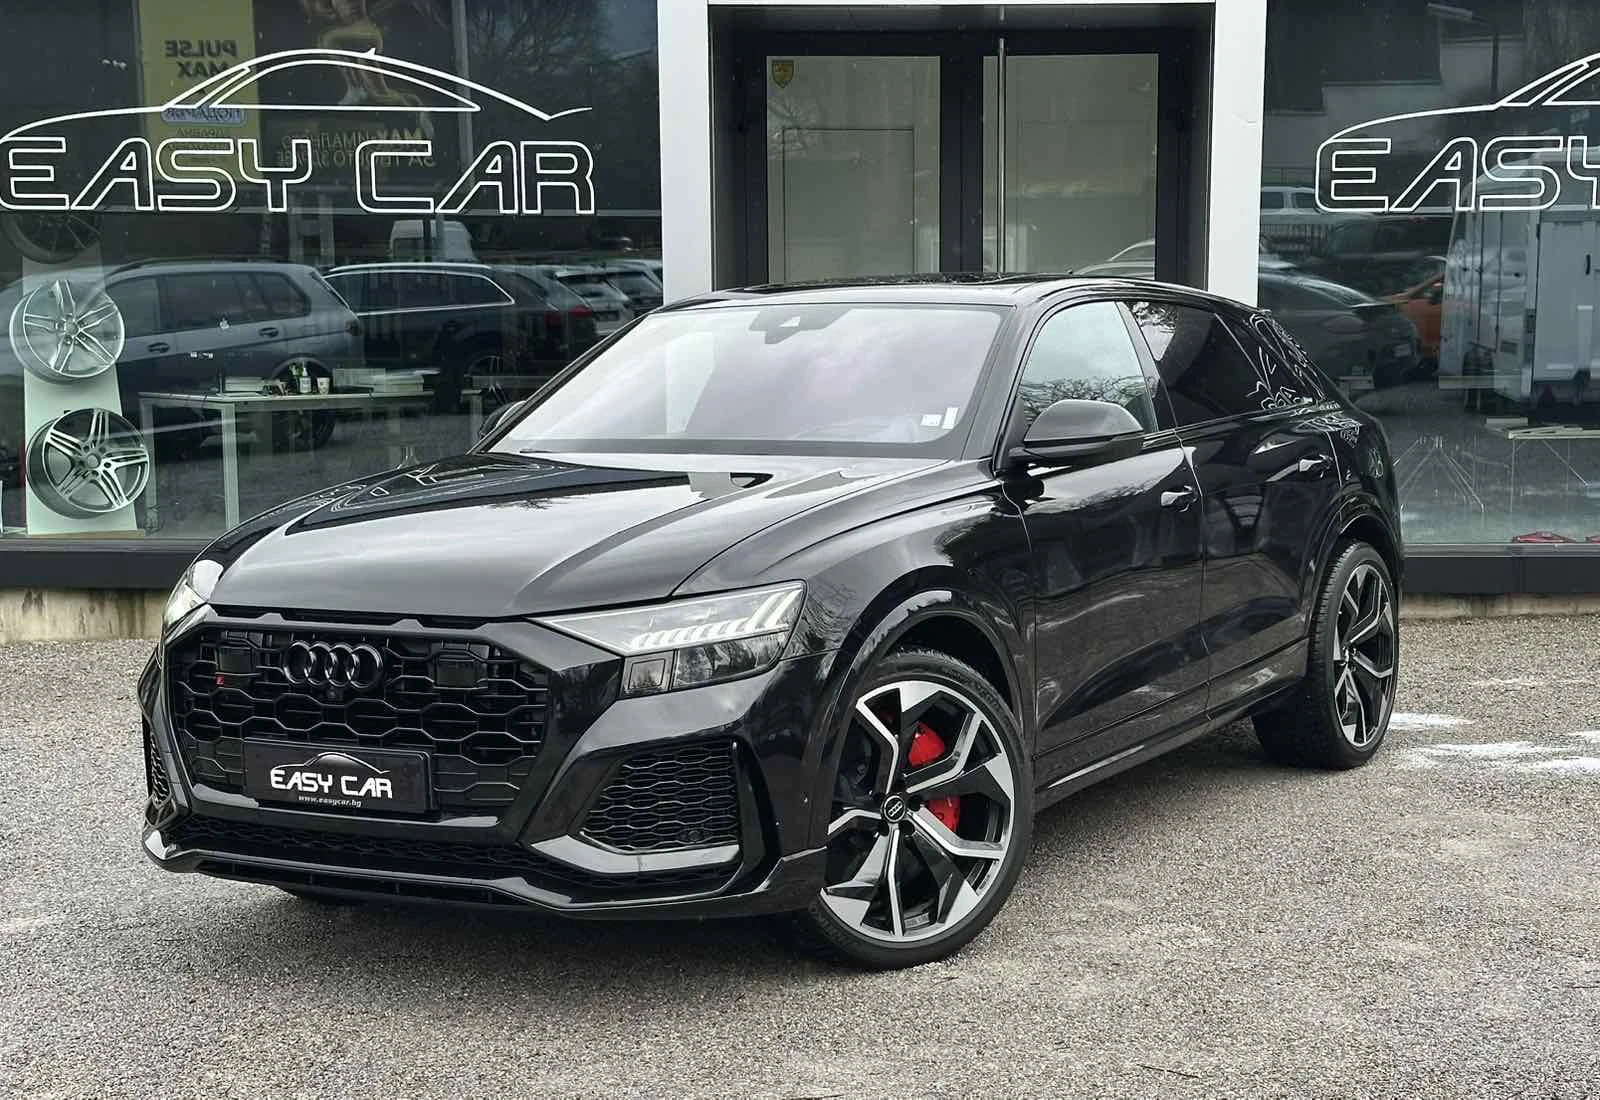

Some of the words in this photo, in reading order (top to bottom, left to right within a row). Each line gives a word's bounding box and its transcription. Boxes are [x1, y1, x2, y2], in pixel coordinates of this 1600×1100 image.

[0, 136, 313, 213] EASY
[355, 139, 596, 214] CAR
[270, 770, 333, 793] EASY
[340, 775, 393, 798] CAR
[298, 795, 363, 808] www.easycar.bg
